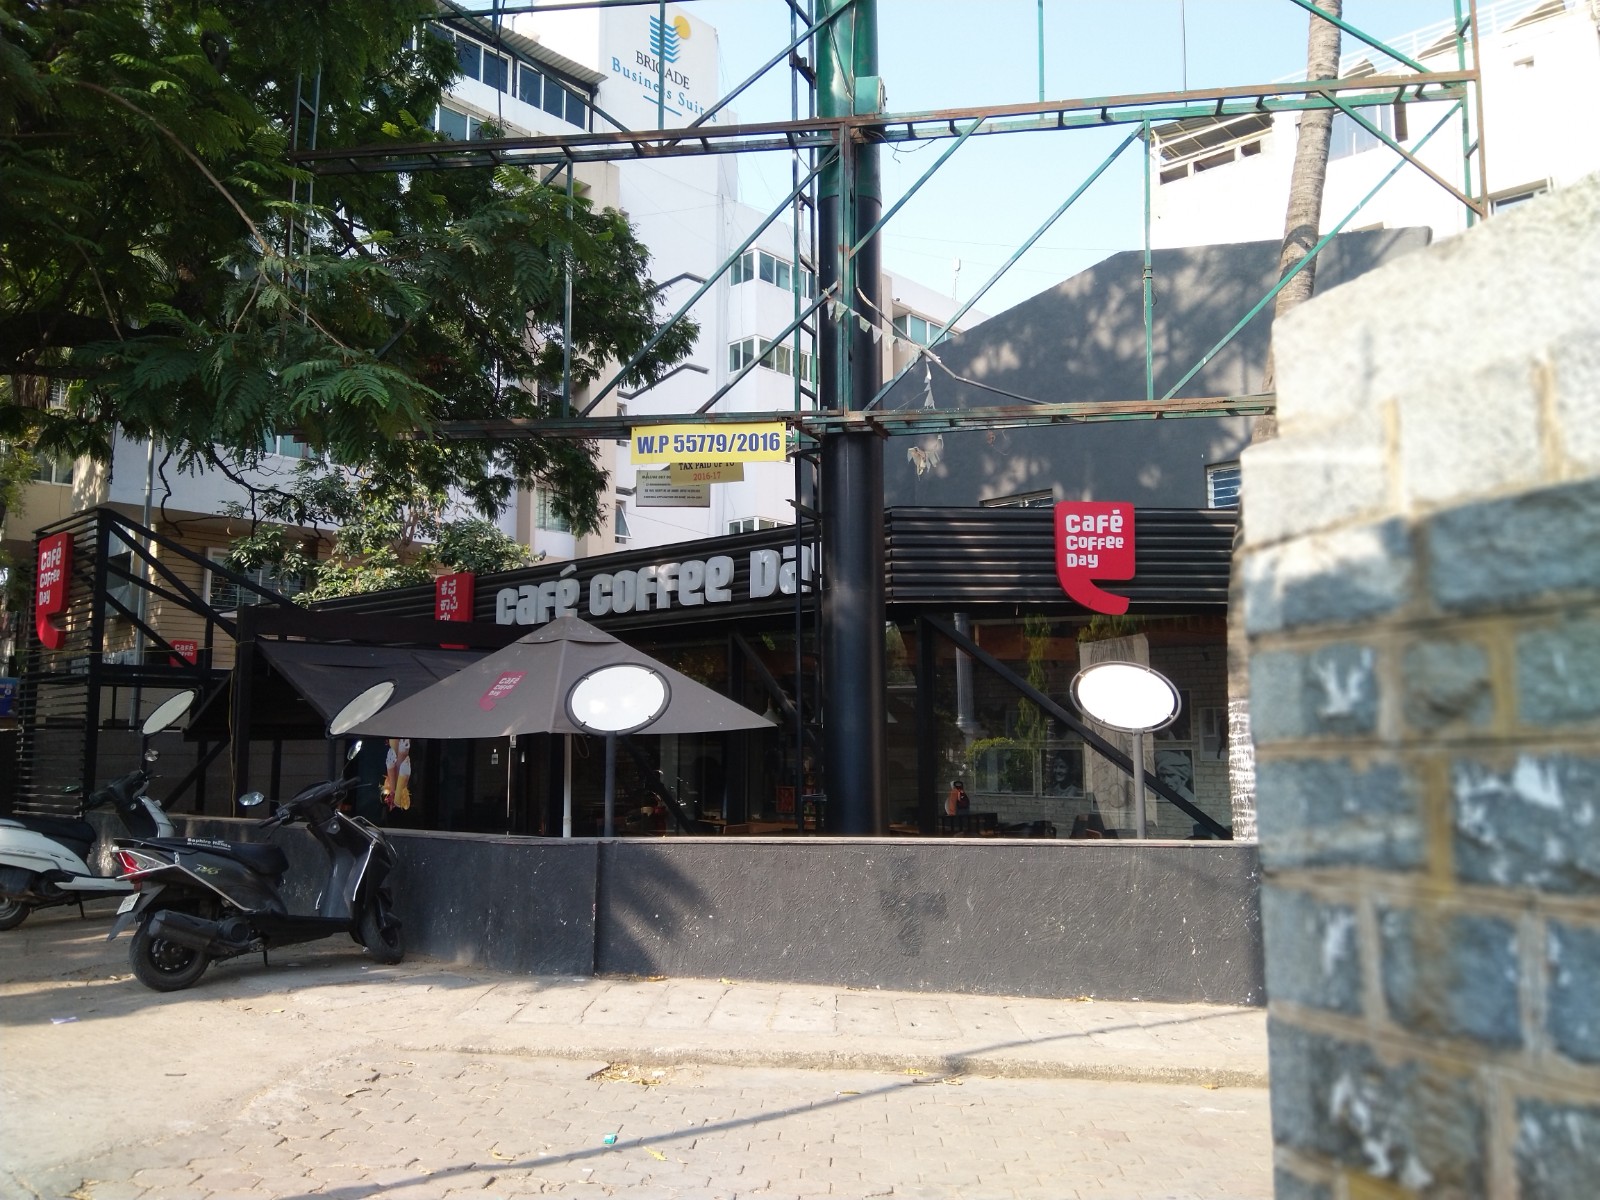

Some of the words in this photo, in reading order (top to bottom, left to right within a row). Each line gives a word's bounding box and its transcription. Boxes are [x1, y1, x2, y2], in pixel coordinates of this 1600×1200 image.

[611, 56, 672, 99] Busines
[678, 92, 717, 123] Suits
[637, 435, 669, 454] W.P
[674, 432, 781, 453] 55779/2016
[678, 462, 693, 471] TAX
[693, 471, 721, 481] 2016-17
[1065, 509, 1123, 534] Café
[1066, 535, 1124, 551] Coffee
[1066, 553, 1098, 568] Day
[749, 542, 823, 599] Da
